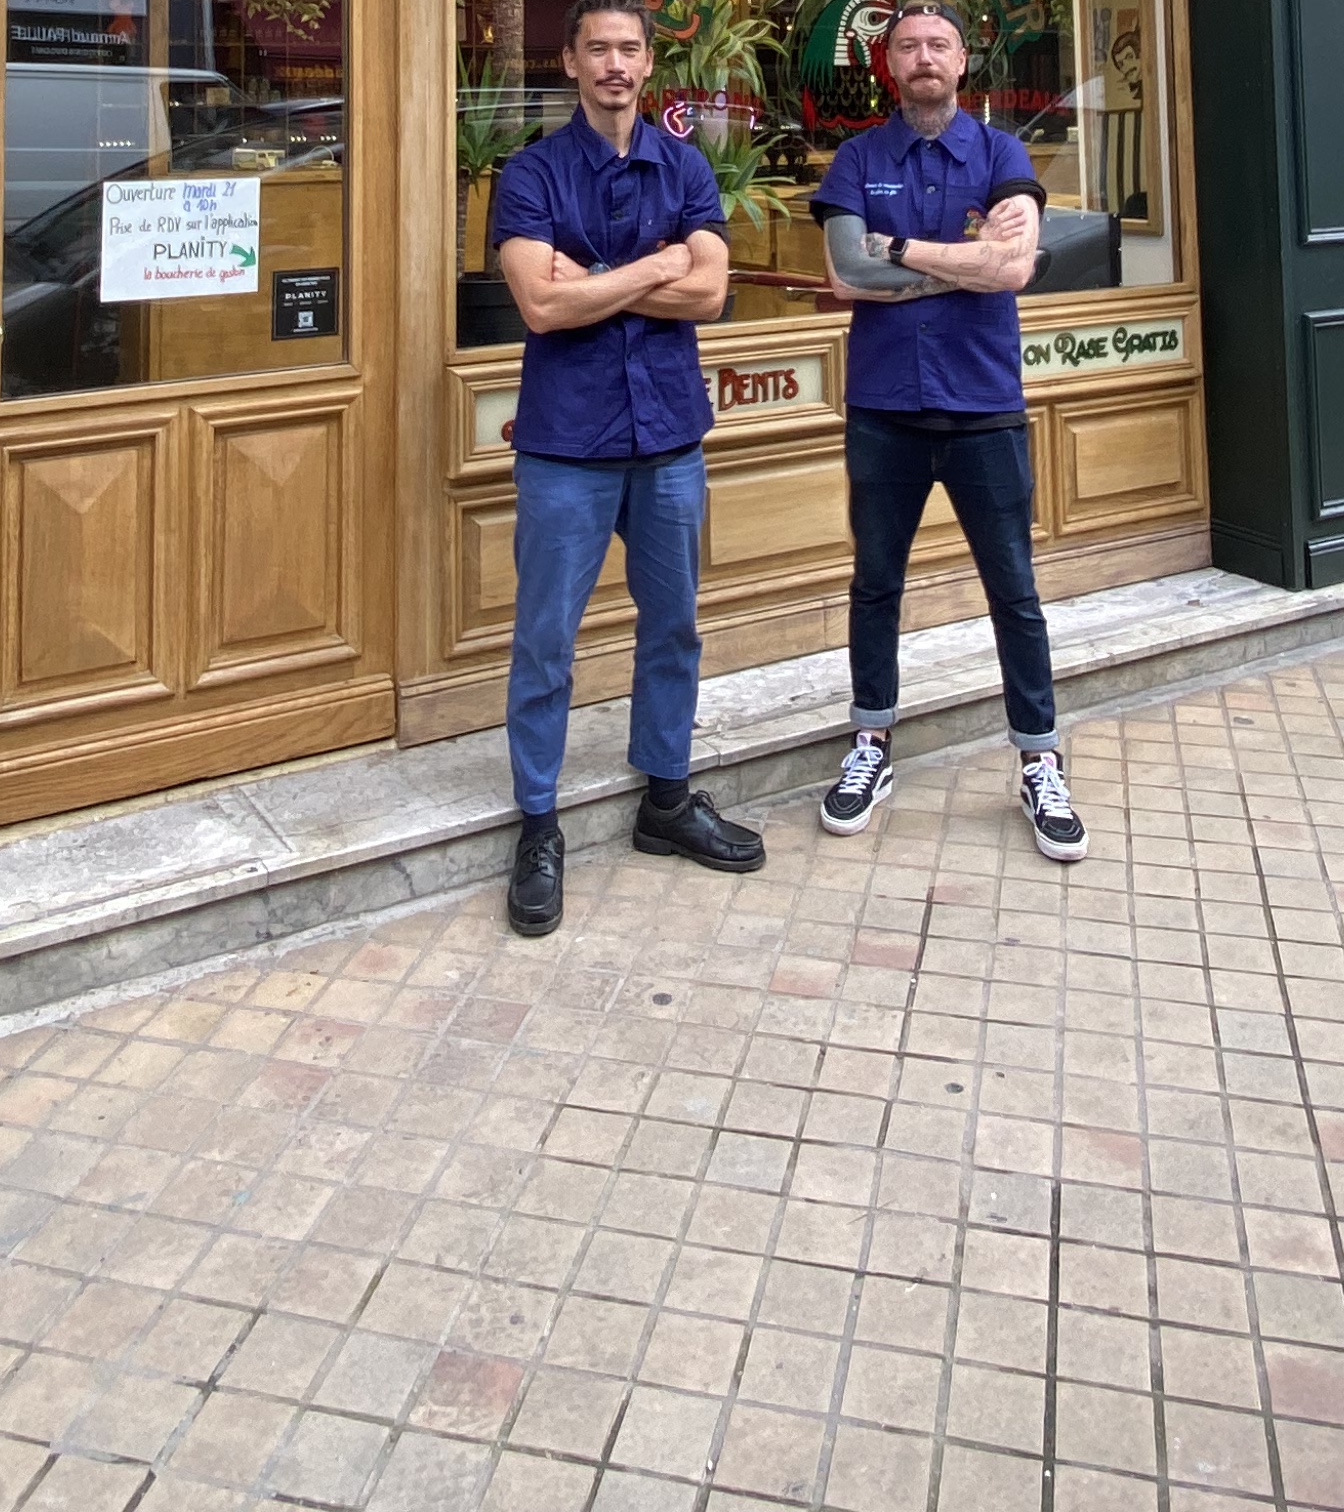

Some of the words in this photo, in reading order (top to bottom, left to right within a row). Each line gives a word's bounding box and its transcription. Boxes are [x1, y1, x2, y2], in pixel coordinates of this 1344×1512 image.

[106, 182, 177, 205] Ouverture
[139, 220, 152, 233] de
[157, 216, 181, 233] RDV
[186, 219, 203, 231] sur
[155, 264, 203, 280] boucherie
[205, 267, 217, 279] de
[284, 290, 327, 300] PLANITY
[1022, 342, 1051, 366] ON
[1053, 331, 1109, 368] RASE
[1112, 326, 1179, 363] GRATIS
